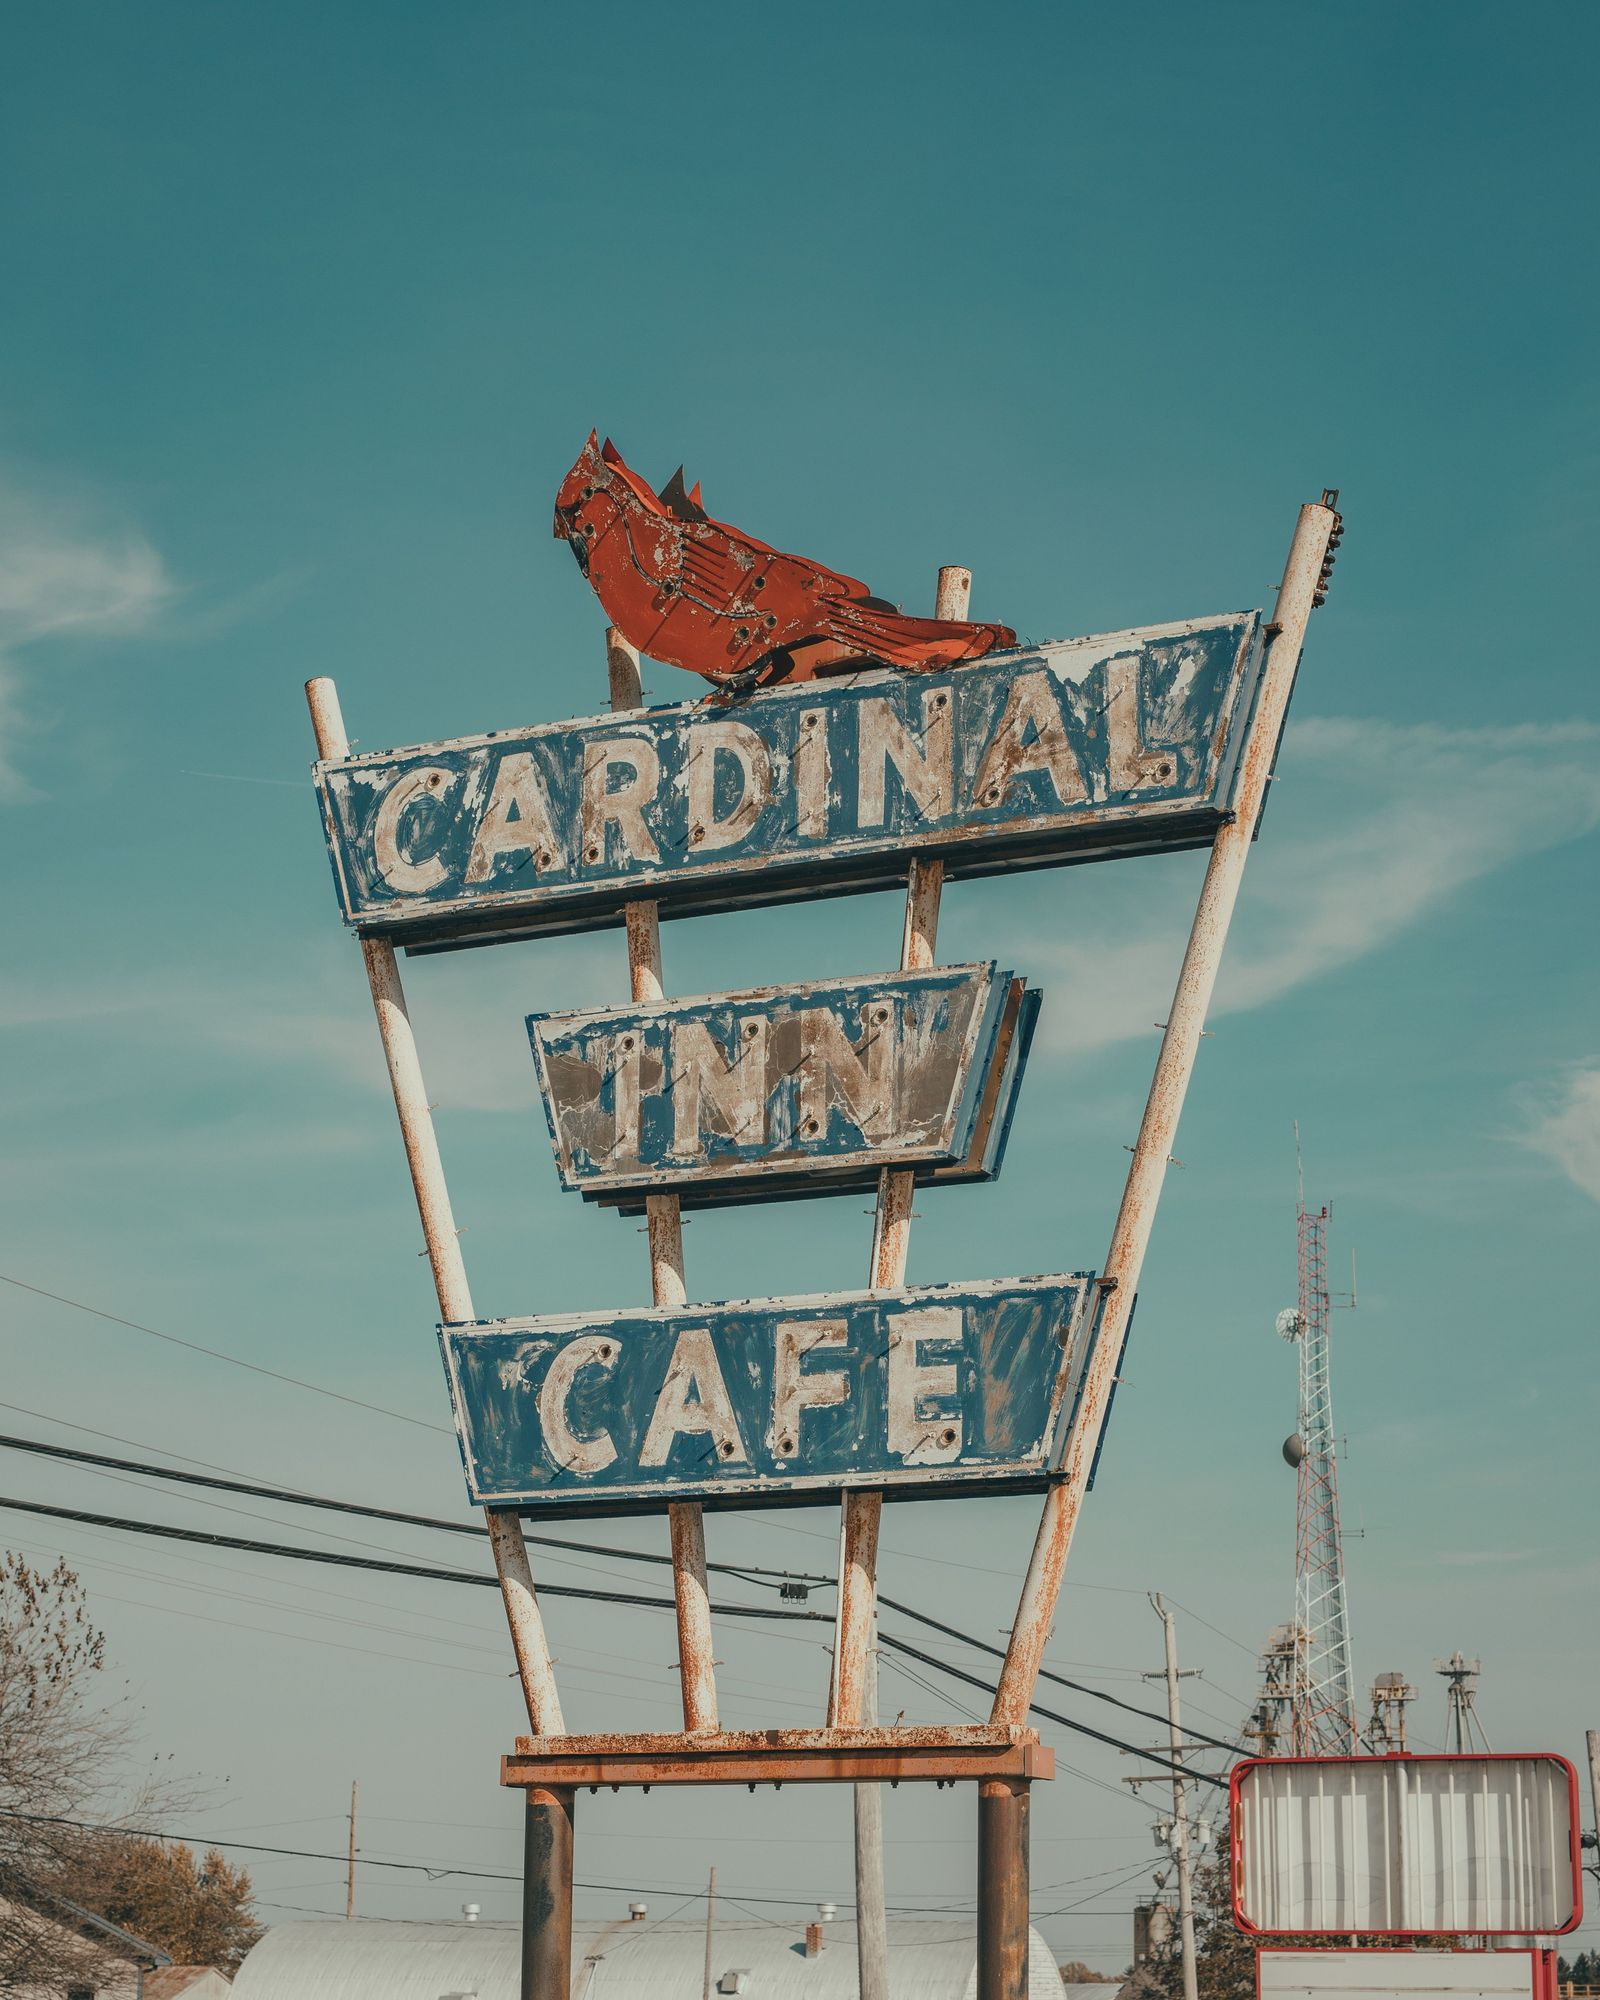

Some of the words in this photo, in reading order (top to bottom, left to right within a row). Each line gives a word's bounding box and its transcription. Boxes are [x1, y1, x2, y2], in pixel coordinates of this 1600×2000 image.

[373, 656, 1178, 894] CARDINAL
[613, 1000, 895, 1160] INN
[537, 1305, 964, 1474] CAFE
